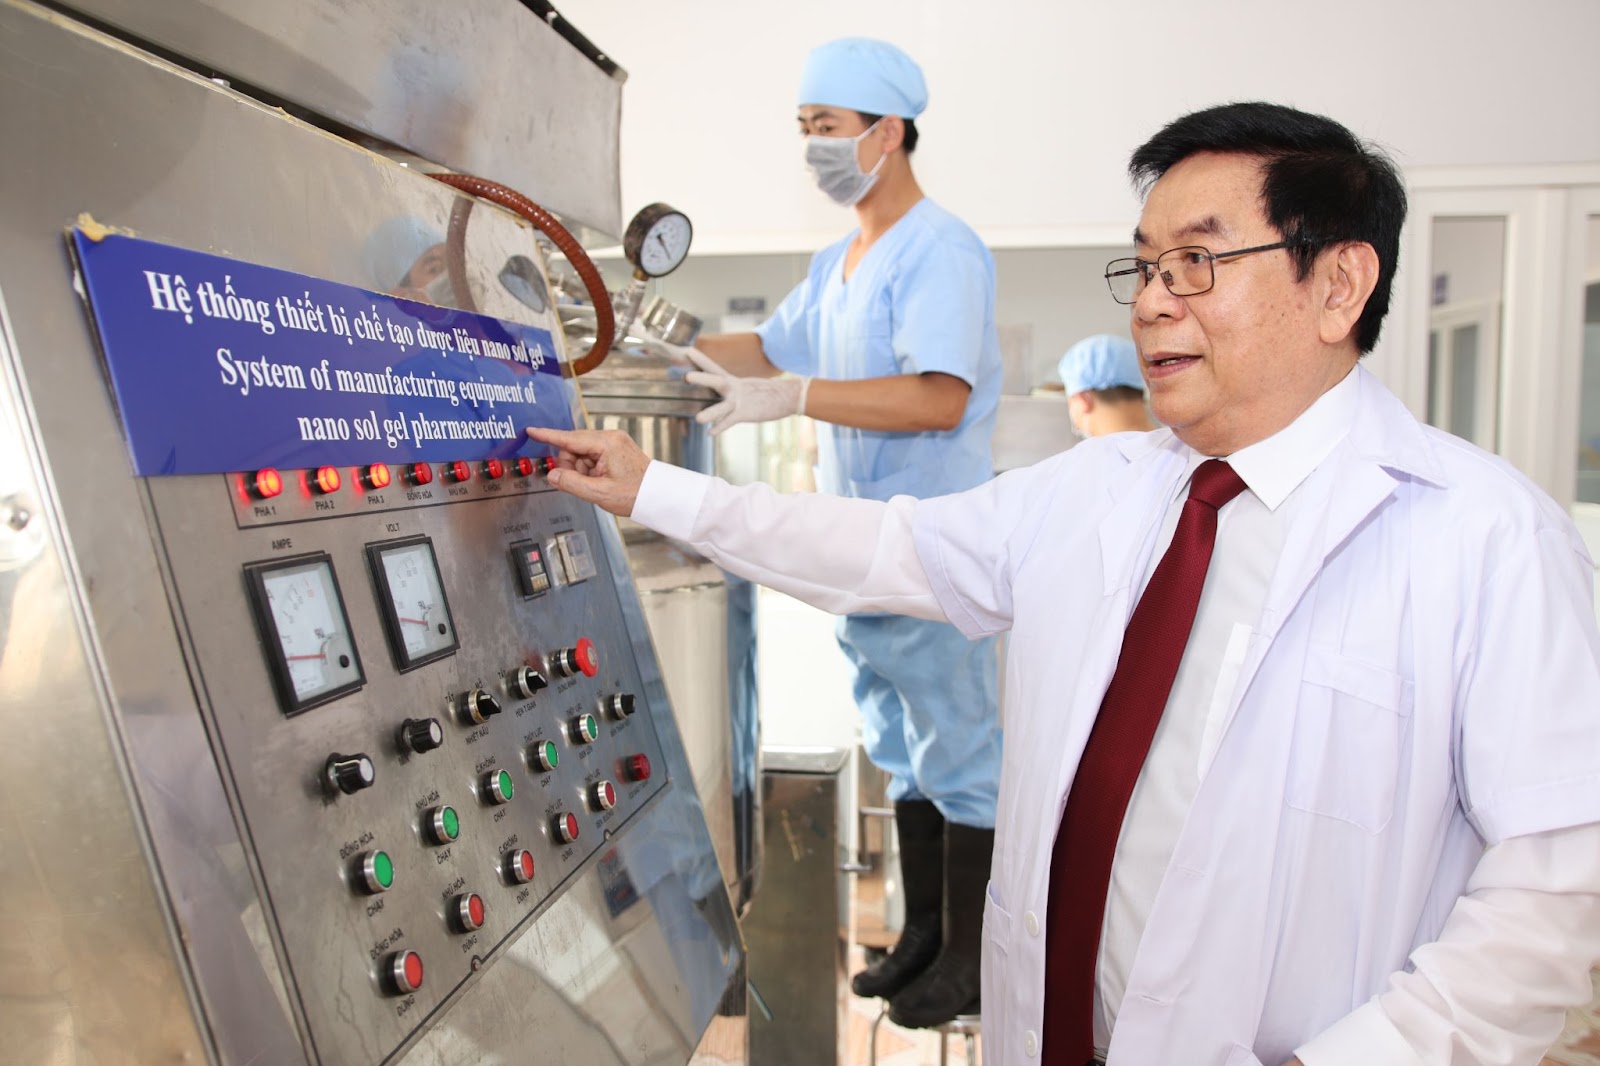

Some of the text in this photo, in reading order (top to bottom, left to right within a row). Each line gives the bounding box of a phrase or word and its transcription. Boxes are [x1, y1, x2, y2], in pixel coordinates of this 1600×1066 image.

[143, 270, 546, 371] Hệ thống thiết bị chế tạo dược liệu nano sol gel
[216, 347, 537, 408] System of manufacturing equipment of
[297, 410, 517, 449] nano sol gel pharmaceutical
[315, 500, 335, 511] PHA 2
[367, 495, 385, 505] PHA 3
[254, 506, 277, 517] PHA 1
[386, 522, 400, 533] VOLT
[272, 538, 293, 550] AMPE
